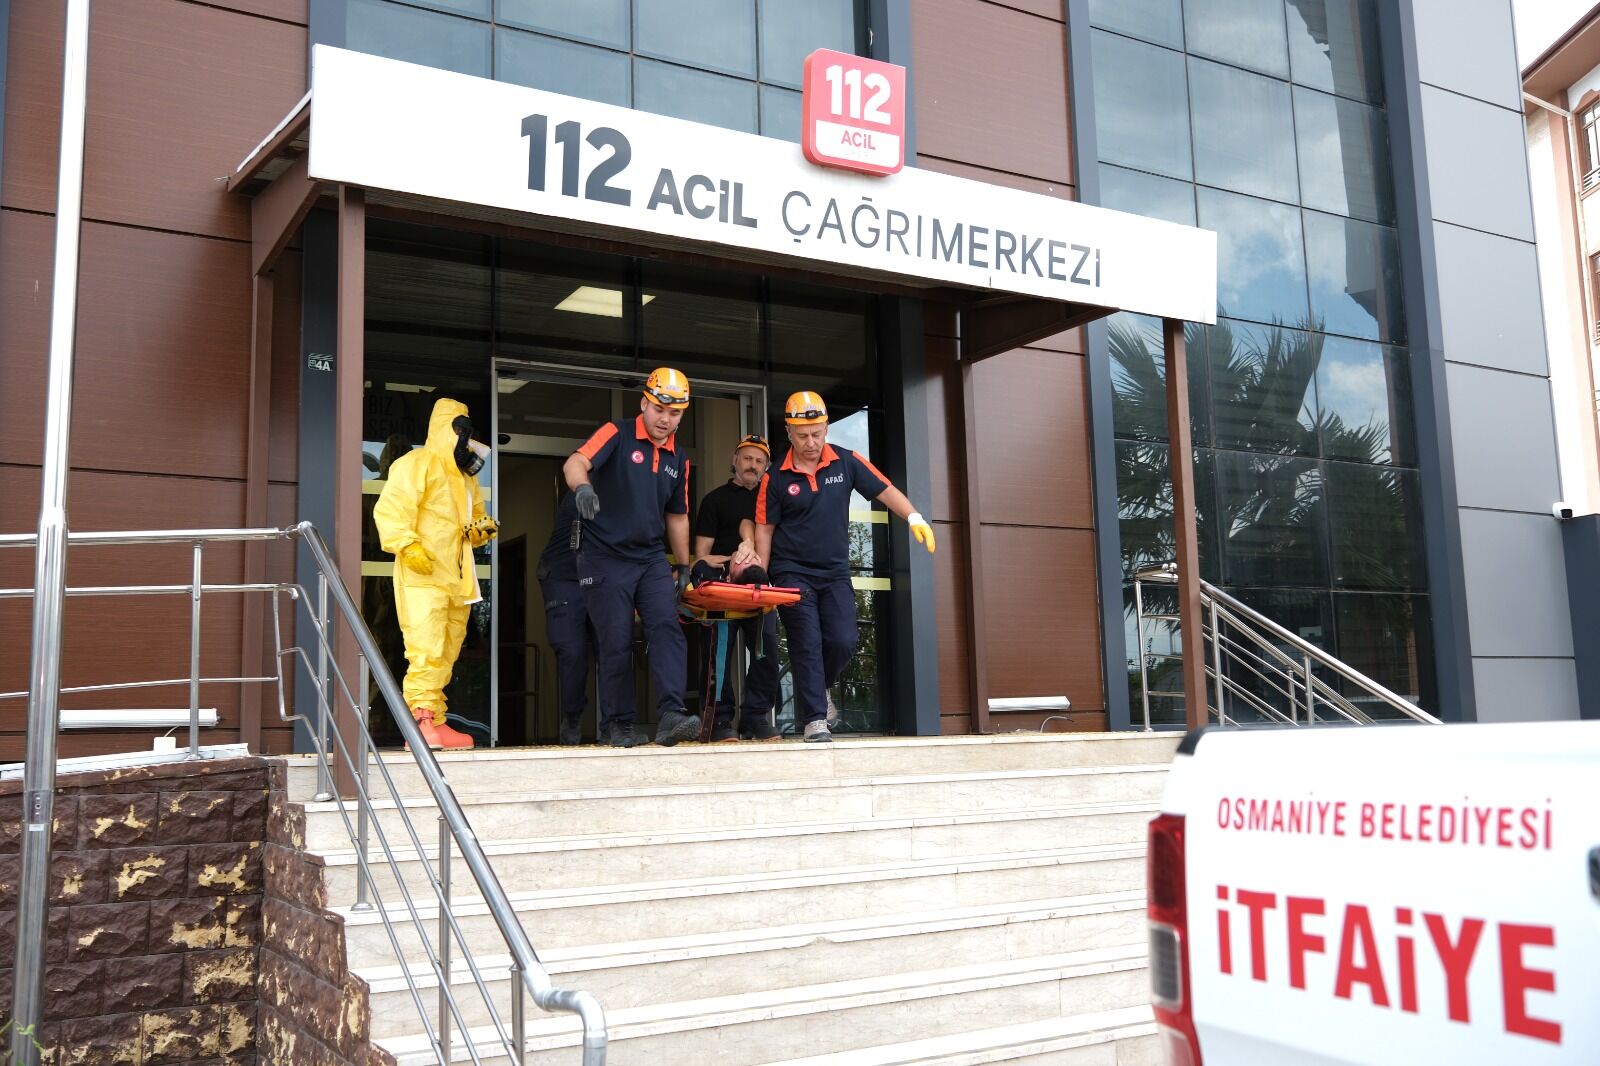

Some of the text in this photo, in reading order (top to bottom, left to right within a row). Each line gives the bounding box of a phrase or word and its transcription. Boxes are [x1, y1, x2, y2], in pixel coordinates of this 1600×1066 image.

[825, 65, 890, 125] 112
[521, 113, 632, 207] 112
[825, 474, 844, 485] AFAD
